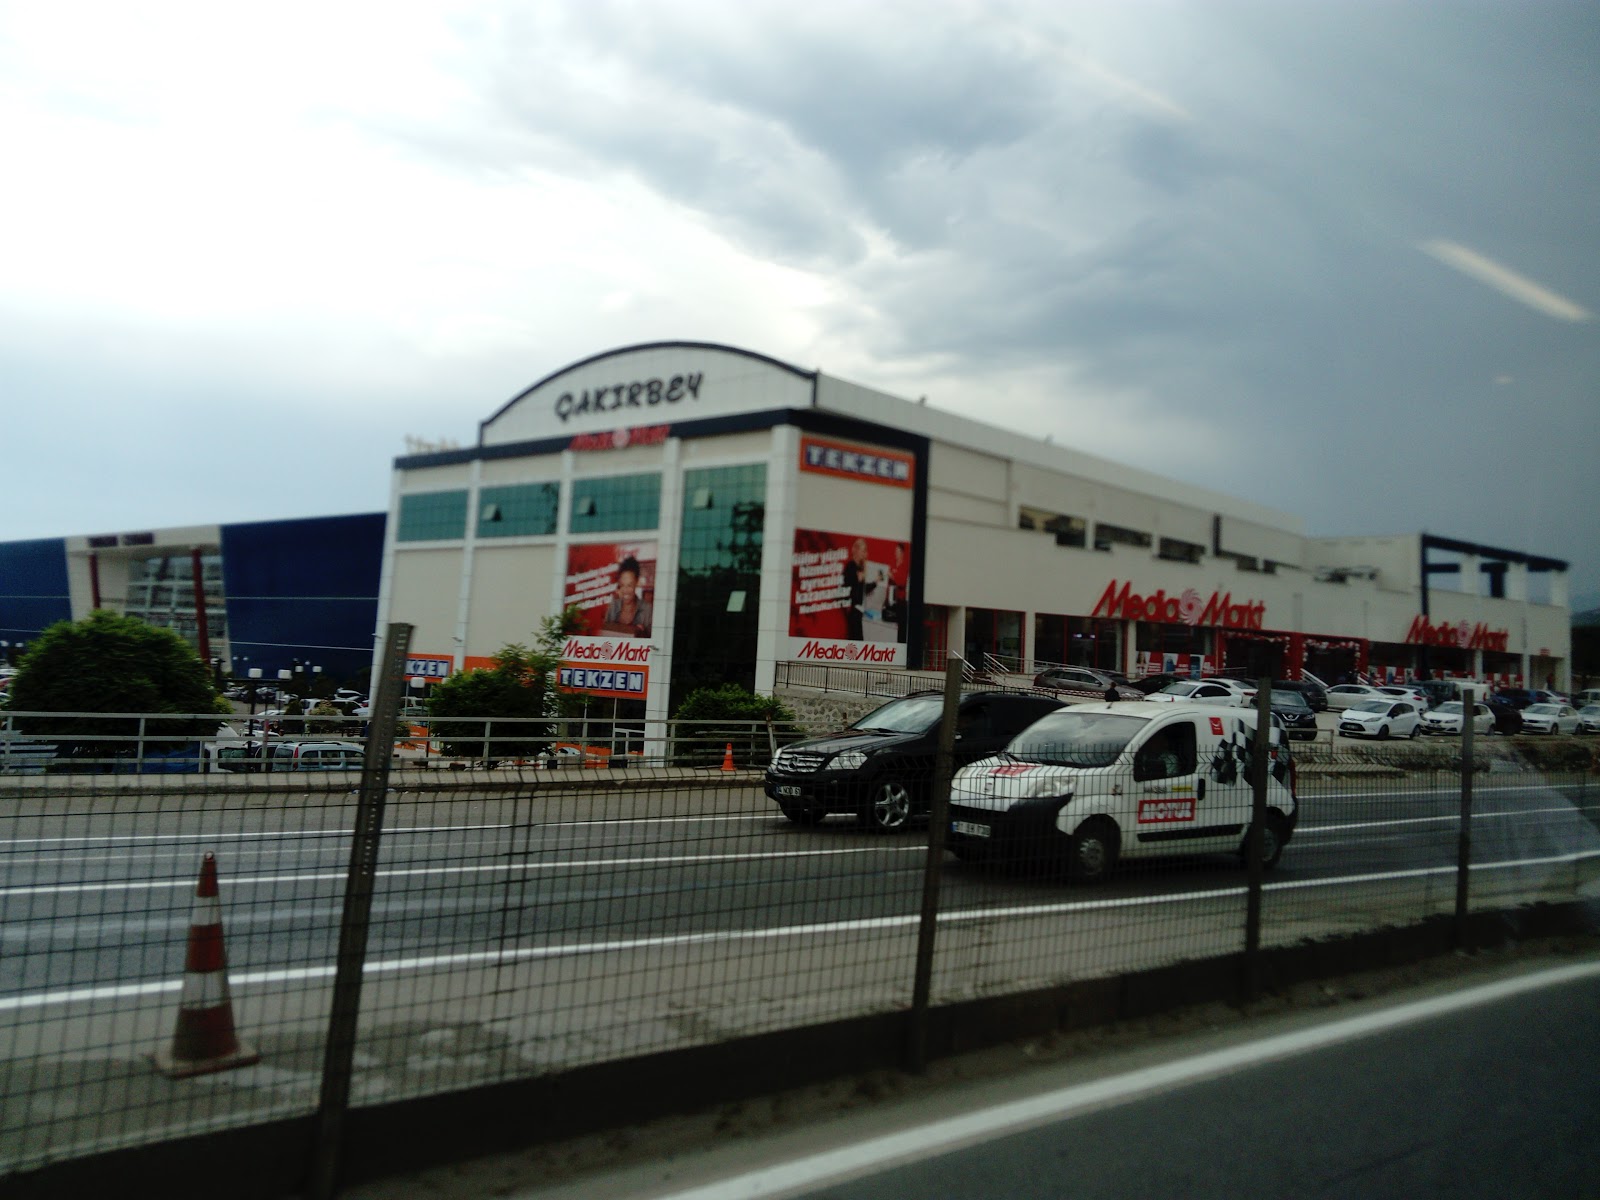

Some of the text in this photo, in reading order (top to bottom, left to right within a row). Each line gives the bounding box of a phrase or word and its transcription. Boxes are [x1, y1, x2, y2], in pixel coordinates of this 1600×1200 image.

[556, 373, 702, 421] ÇAKIRBEY
[807, 446, 908, 480] TEKZEN
[1093, 580, 1266, 628] Media Markt
[1406, 615, 1508, 651] Media Markt
[561, 640, 651, 662] Media Markt
[797, 640, 897, 662] Media Markt
[406, 659, 449, 679] KZEN
[560, 670, 643, 692] TEKZEN
[1140, 801, 1192, 820] MOTUL
